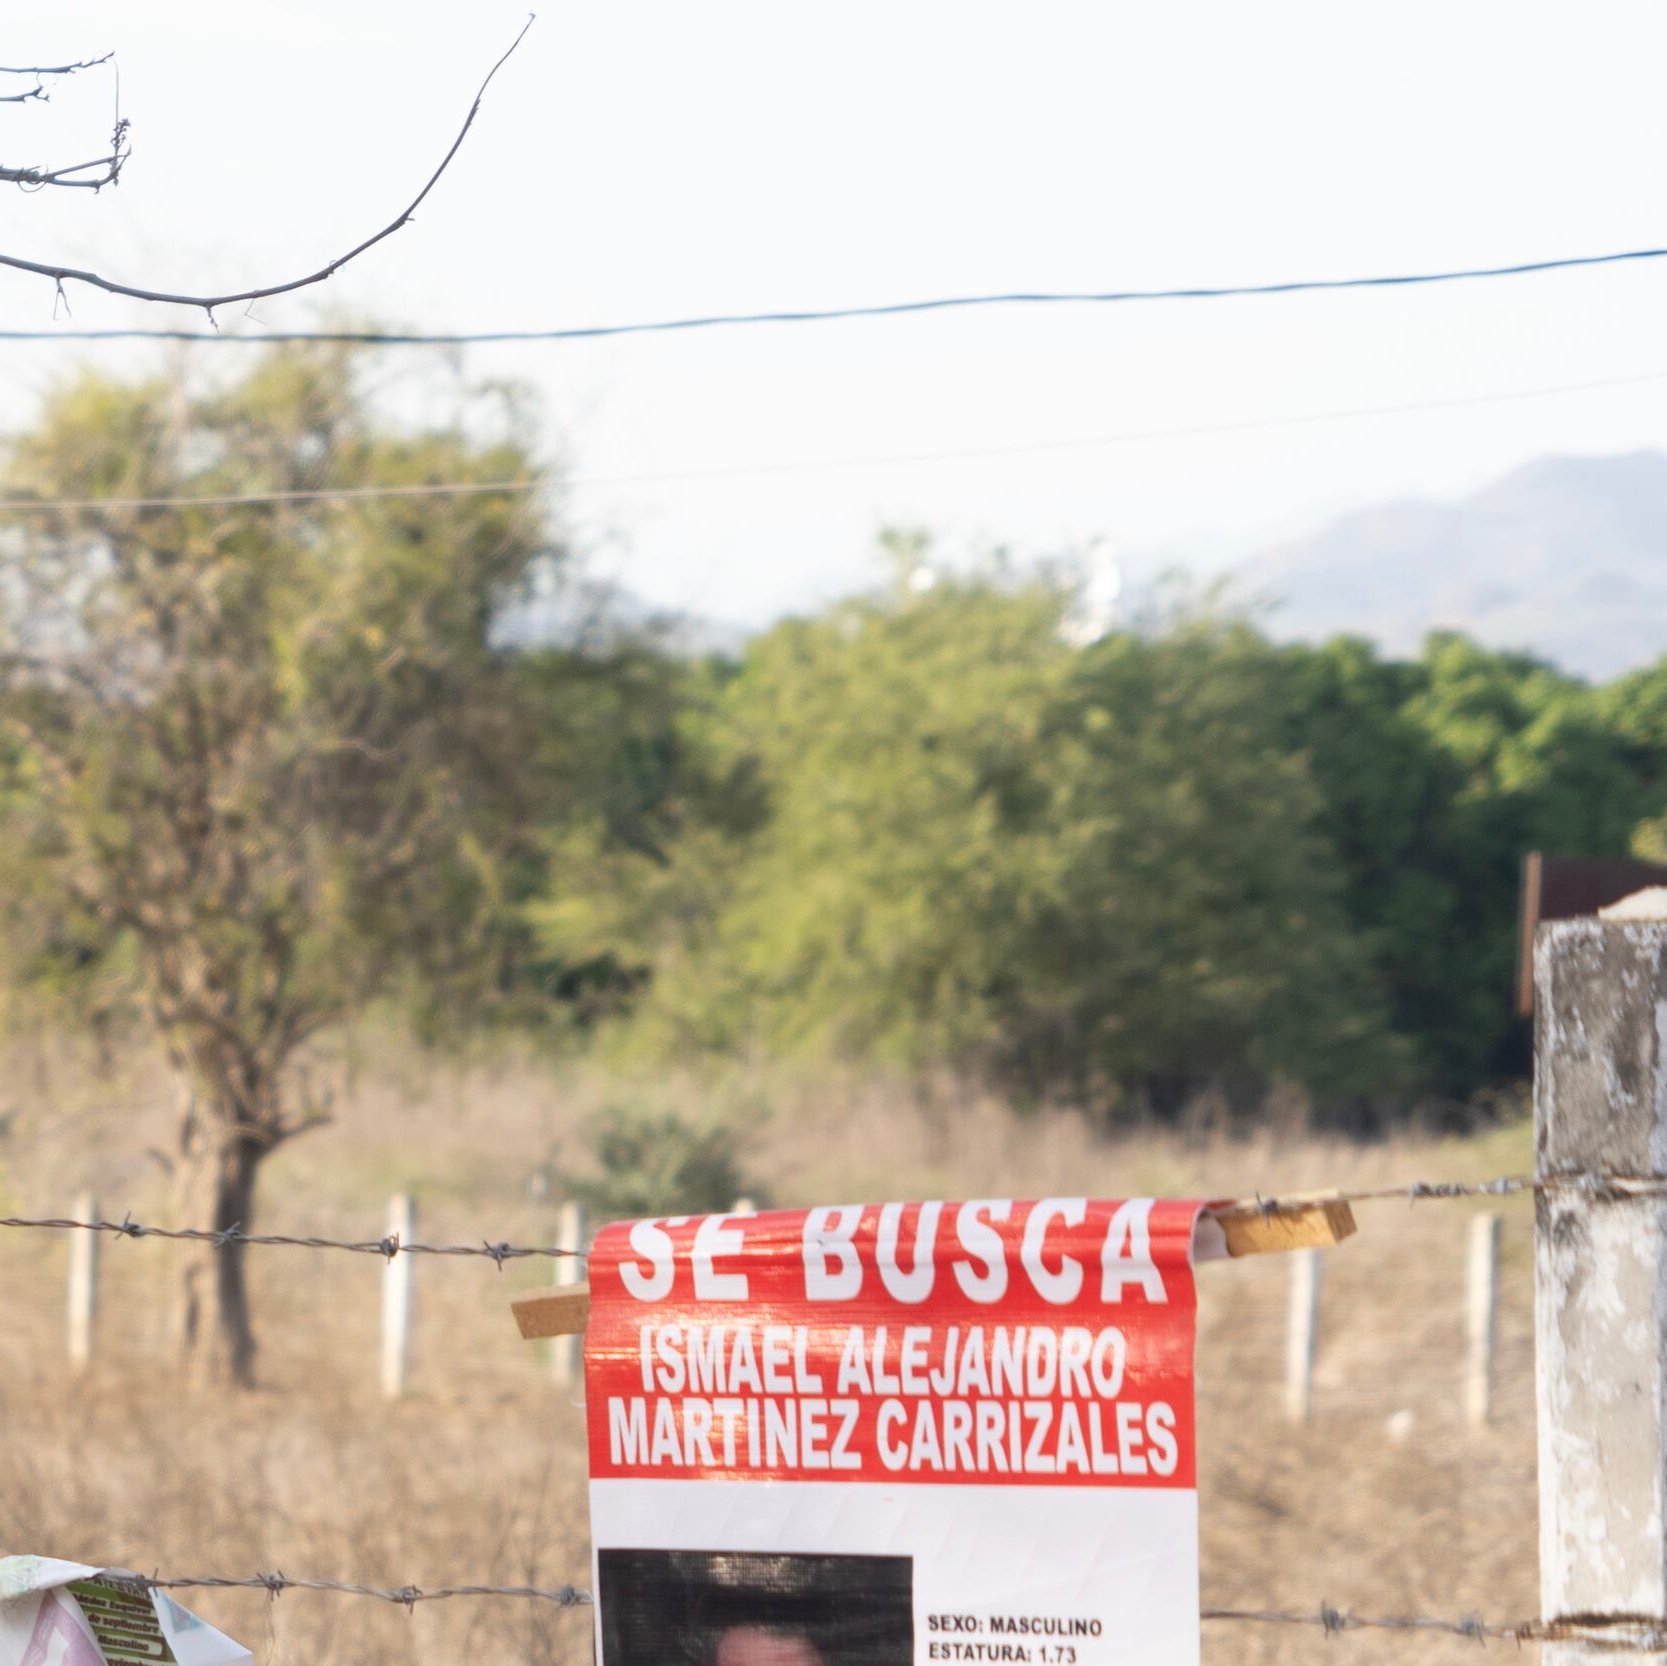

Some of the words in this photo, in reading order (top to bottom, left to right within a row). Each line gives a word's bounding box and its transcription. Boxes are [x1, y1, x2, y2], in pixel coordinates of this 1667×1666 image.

[619, 1212, 758, 1302] SE
[802, 1199, 1169, 1304] BUSCA
[639, 1325, 823, 1395] ISMAEL
[837, 1325, 1127, 1399] ALEJANDRO
[609, 1396, 862, 1470] MARTINEZ
[875, 1401, 1179, 1476] CARRIZALES
[103, 1618, 159, 1635] septiembre
[927, 1616, 984, 1632] SEXO:
[989, 1617, 1102, 1636] MASCULINO
[98, 1635, 150, 1652] Masculino
[928, 1643, 1031, 1661] ESTATURA:
[1039, 1646, 1077, 1664] 1.73
